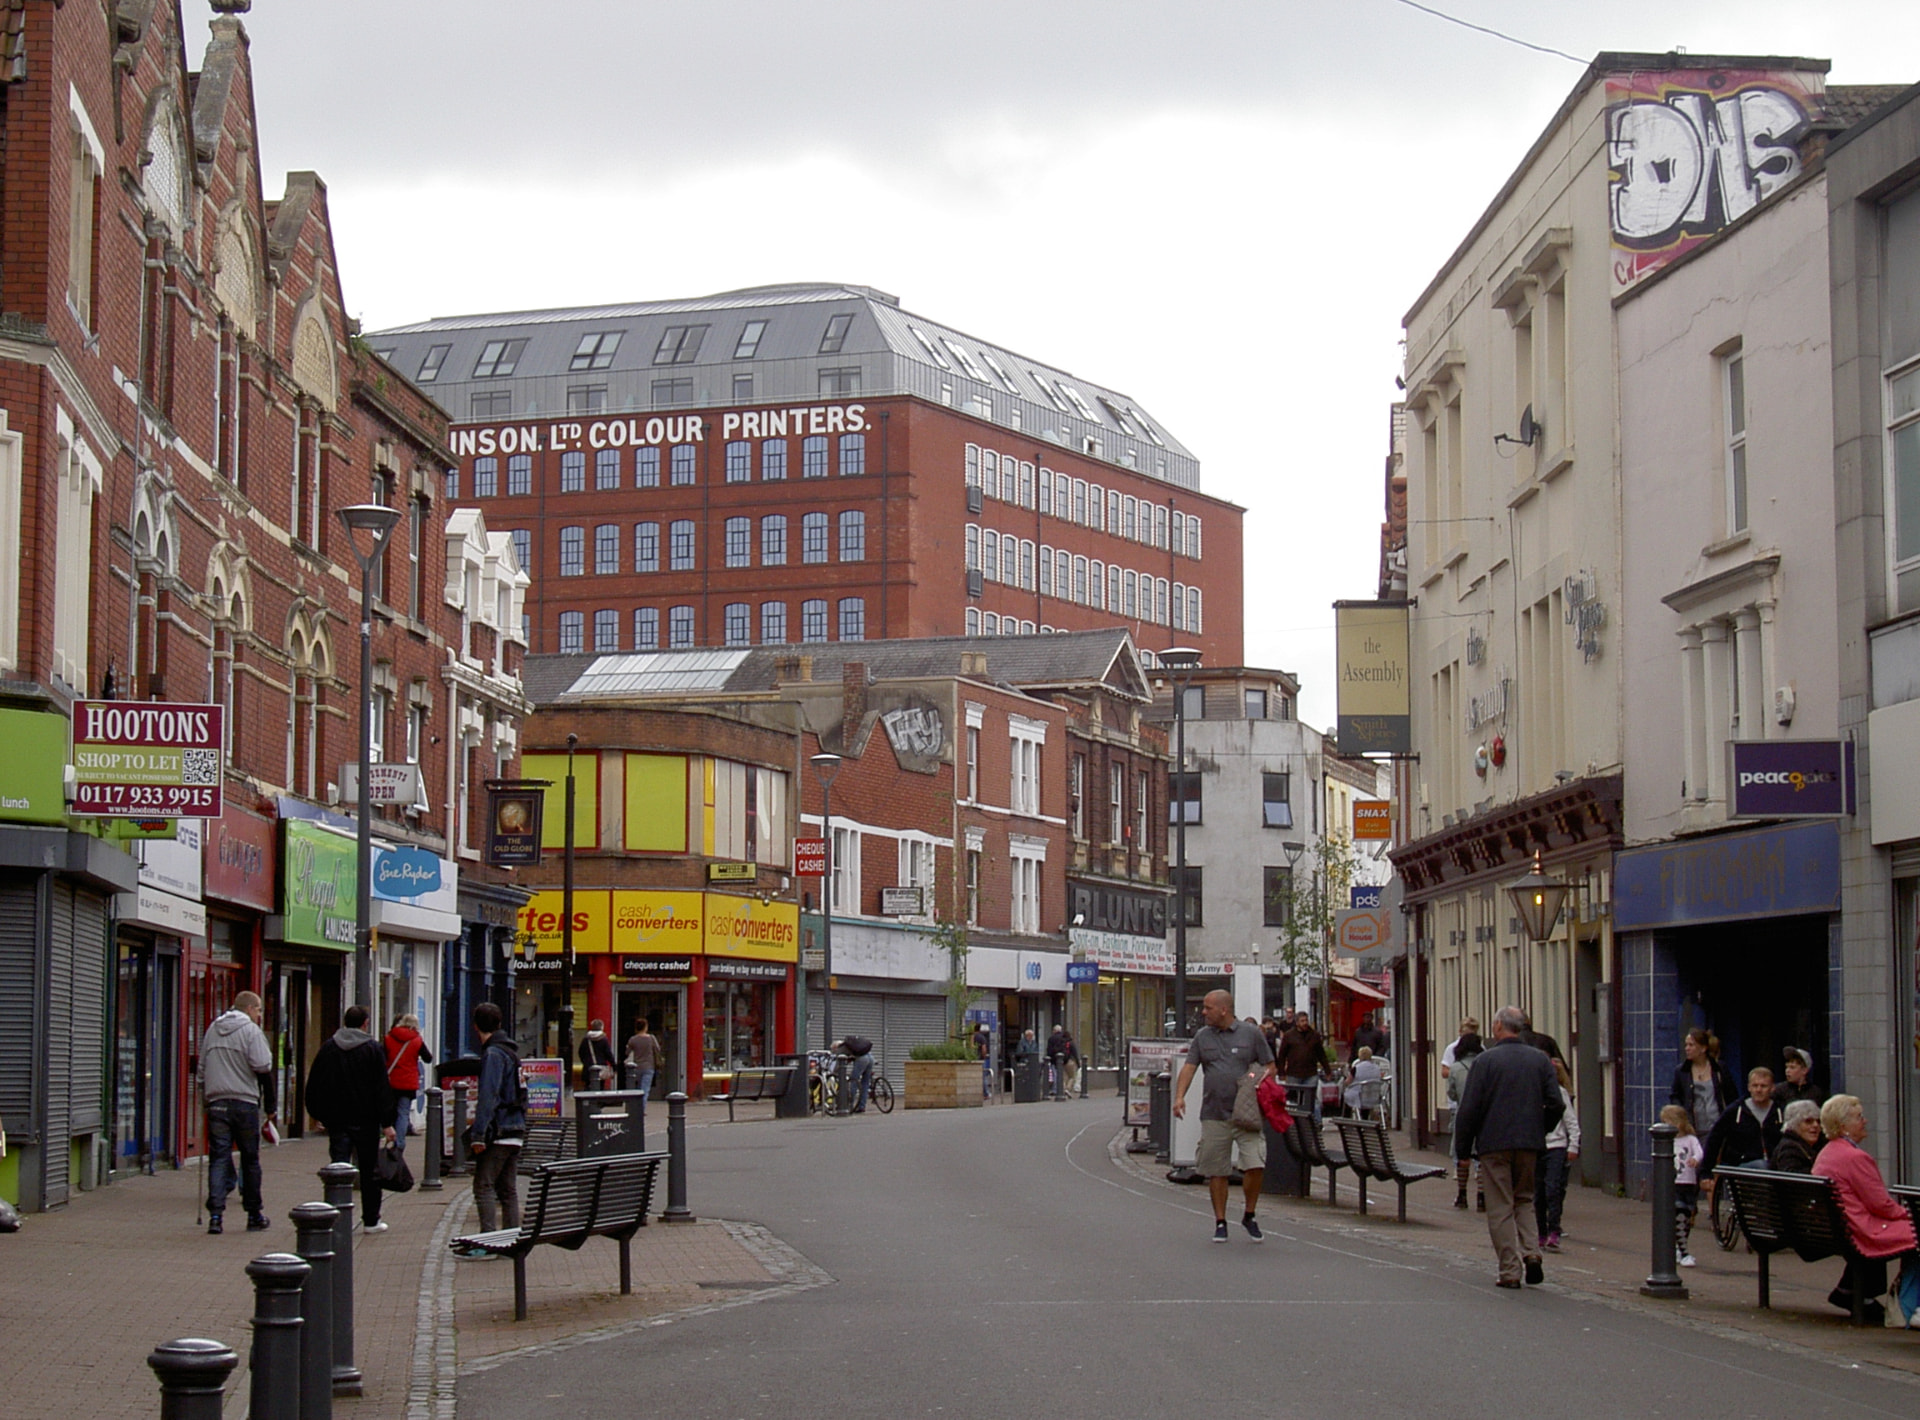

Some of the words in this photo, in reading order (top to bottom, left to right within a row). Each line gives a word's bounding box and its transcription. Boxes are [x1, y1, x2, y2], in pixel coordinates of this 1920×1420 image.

[589, 416, 703, 449] COLOUR
[1364, 636, 1381, 654] the
[1343, 661, 1404, 688] Assembly
[85, 706, 209, 743] HOOTONS
[78, 752, 121, 769] SHOP
[123, 754, 145, 769] TO
[149, 755, 181, 771] LET
[354, 768, 407, 783] SEMENTS
[2, 796, 30, 809] lunch
[80, 785, 125, 804] 0117
[130, 787, 163, 805] 933
[168, 788, 213, 806] 9915
[108, 805, 184, 816] www.hootons.co.uk
[1356, 808, 1389, 818] SNAX
[494, 845, 510, 853] OLD
[510, 845, 533, 853] GLOBE
[796, 842, 825, 855] CHEQUE
[379, 859, 402, 881] Sue
[401, 862, 436, 886] Ryder
[1356, 893, 1380, 909] pds
[619, 904, 652, 917] cash
[1074, 887, 1166, 934] BLUNTS
[616, 916, 699, 930] converters
[513, 960, 536, 970] loan
[538, 959, 562, 970] cash
[624, 961, 658, 972] cheques
[659, 961, 690, 970] cashed
[1197, 966, 1221, 975] Army
[598, 1121, 624, 1131] Litter
